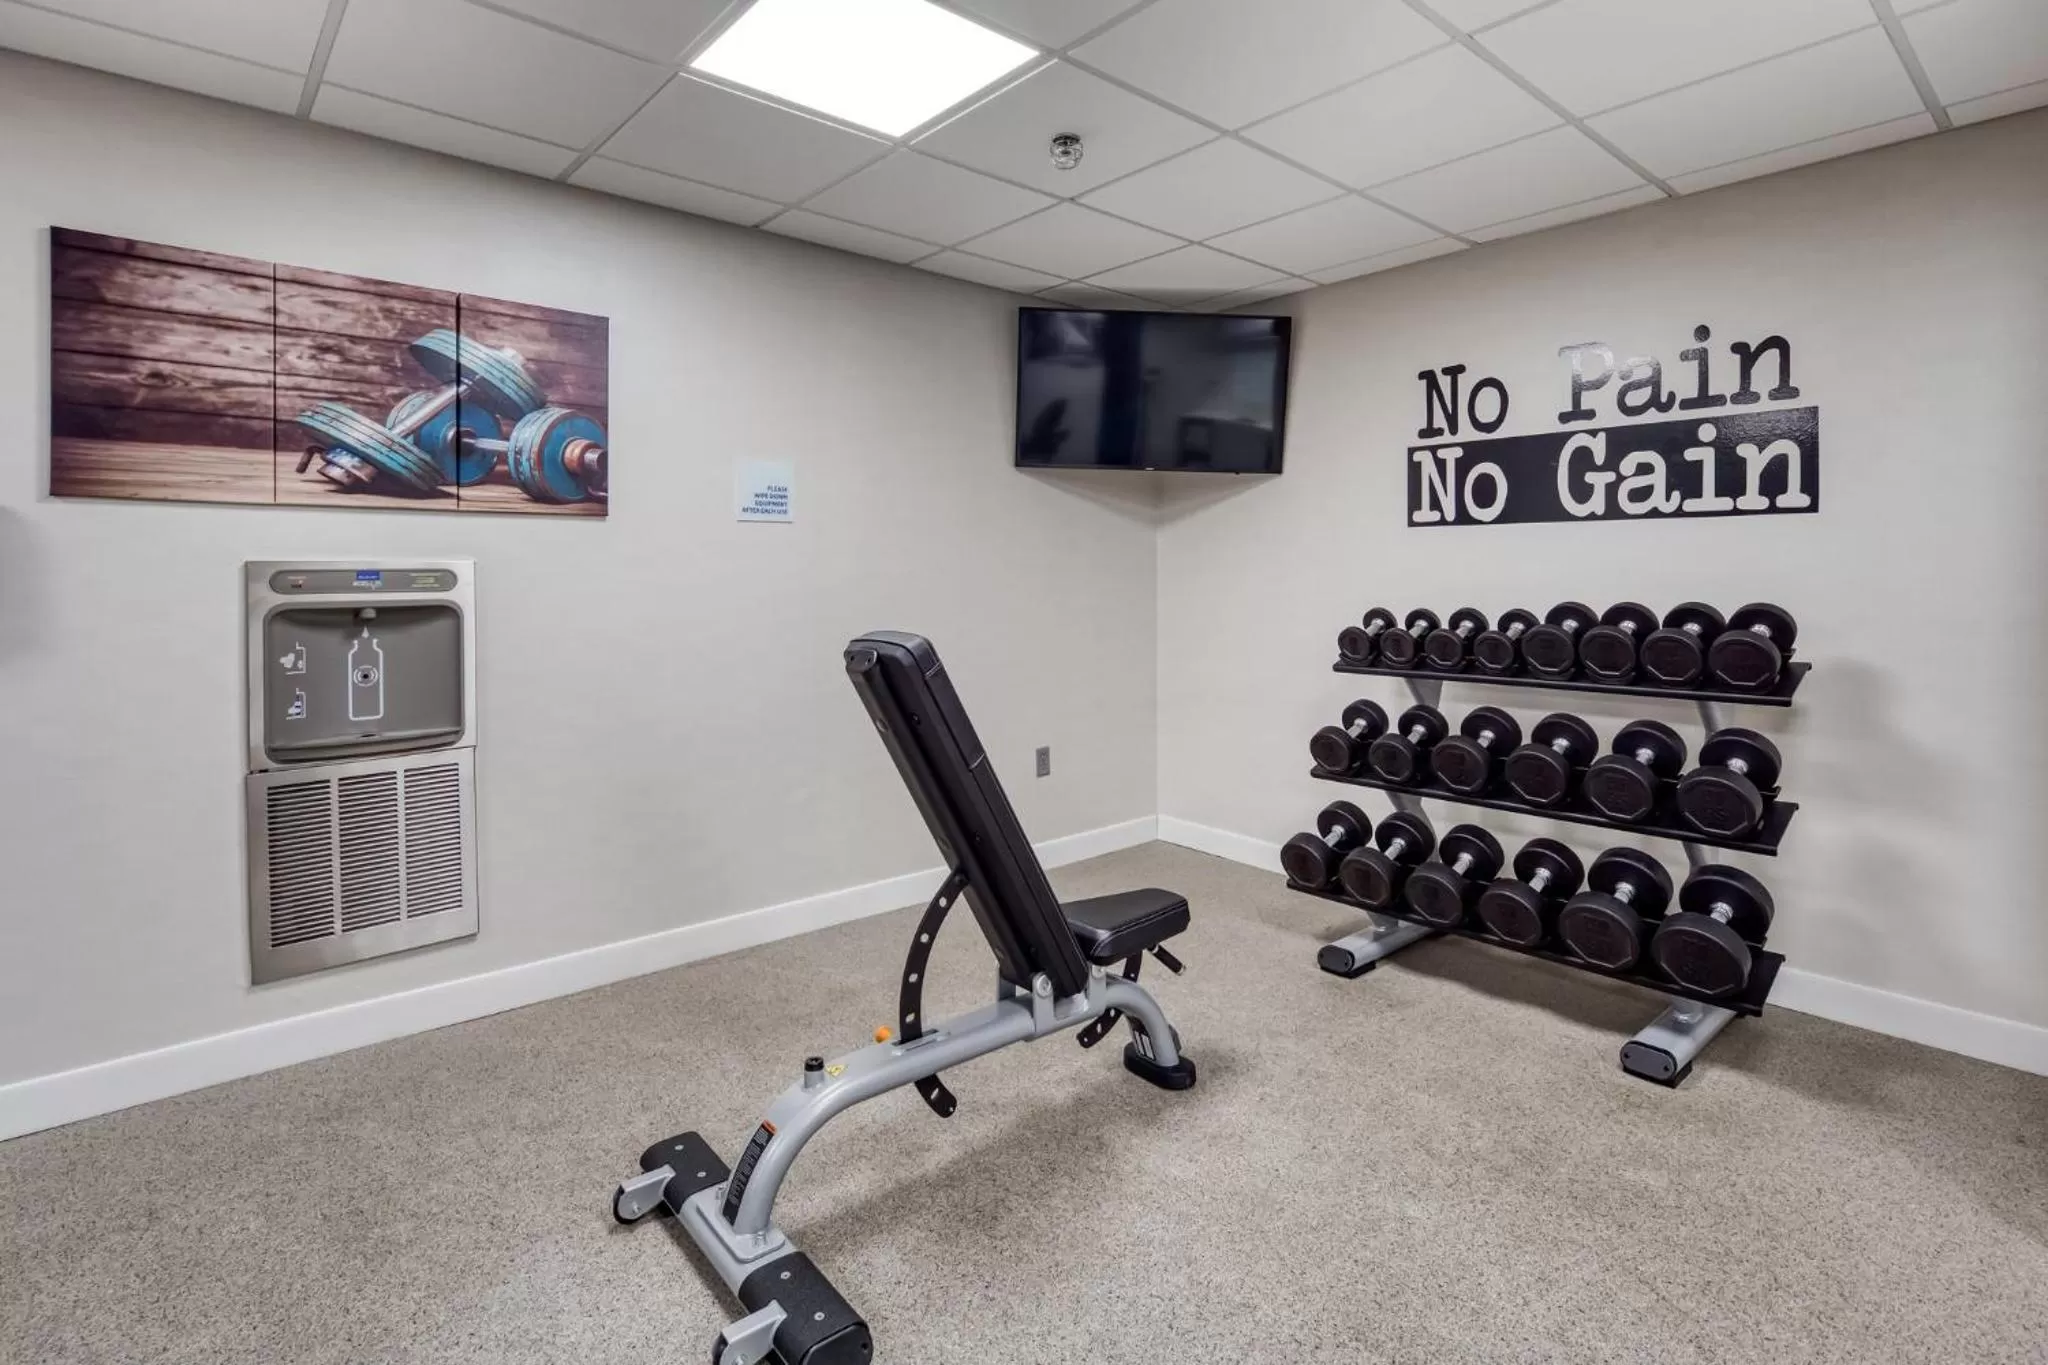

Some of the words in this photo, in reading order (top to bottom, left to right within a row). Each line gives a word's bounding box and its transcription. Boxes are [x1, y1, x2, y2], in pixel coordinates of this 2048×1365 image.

[1417, 364, 1509, 439] No
[1557, 324, 1800, 424] Pain
[1412, 446, 1508, 523] No
[1557, 423, 1811, 518] Gain
